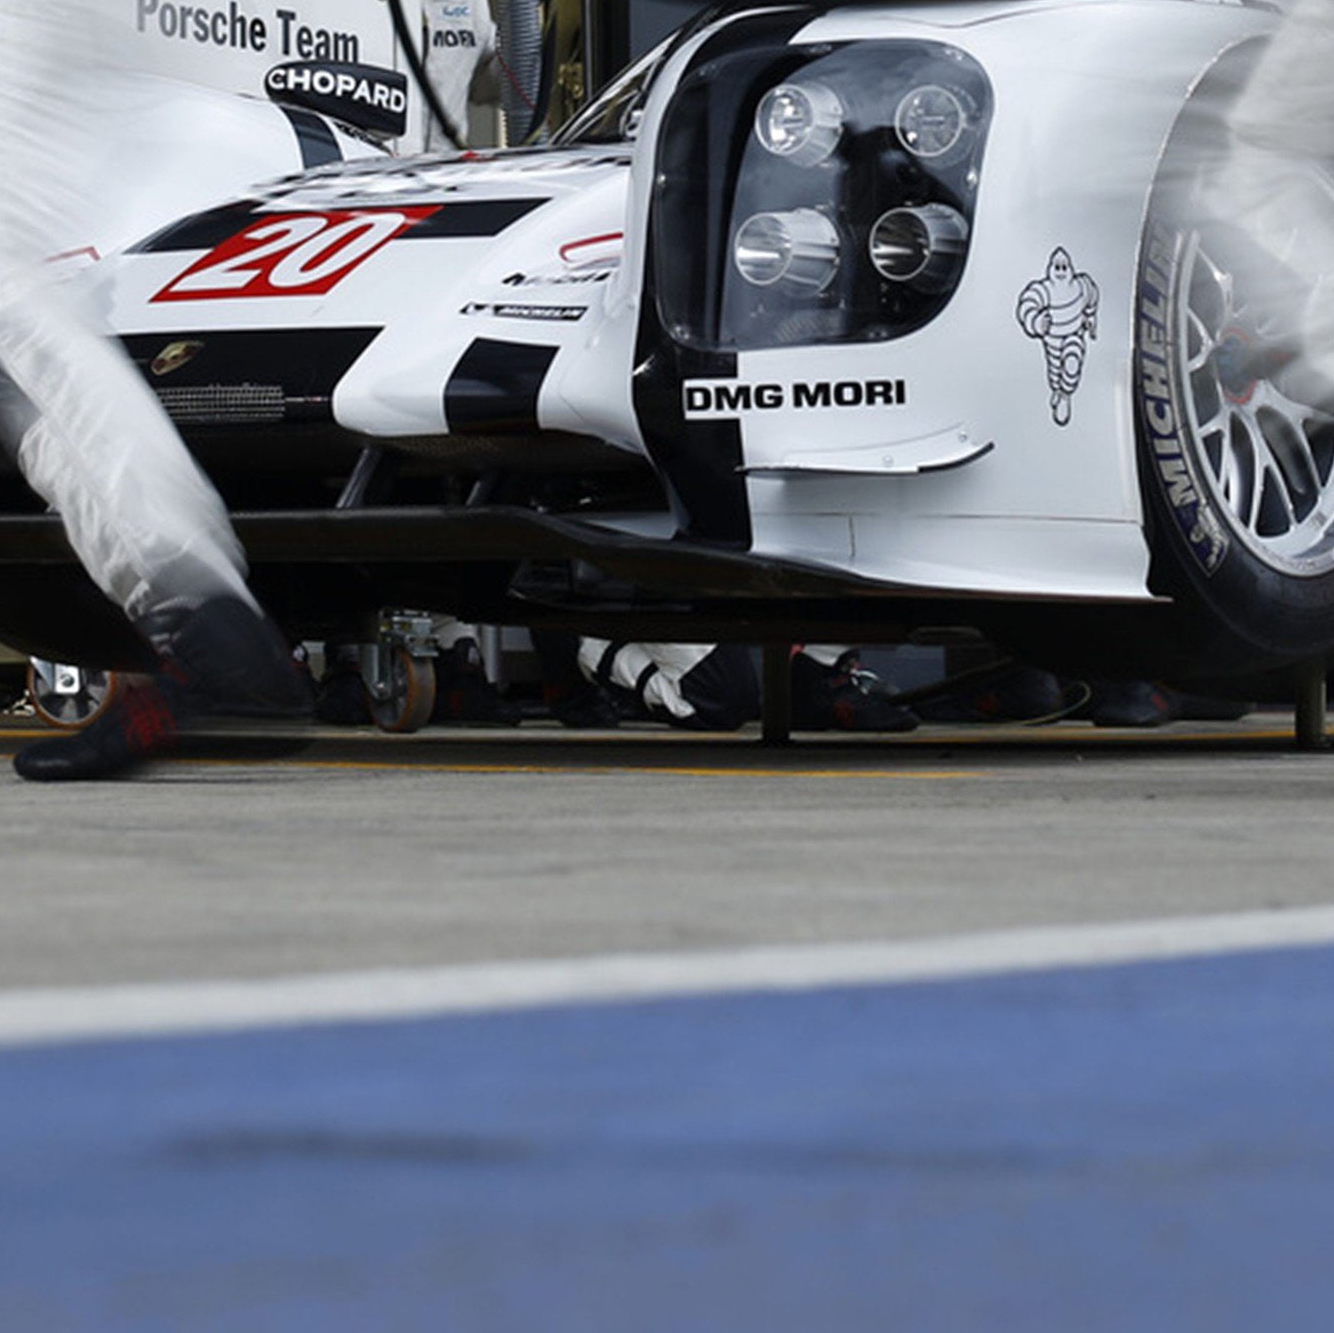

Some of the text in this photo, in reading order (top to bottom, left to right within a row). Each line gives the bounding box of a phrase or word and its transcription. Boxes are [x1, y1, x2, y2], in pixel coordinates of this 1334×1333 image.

[276, 9, 359, 65] Team
[268, 69, 406, 114] CHOPARD
[169, 212, 406, 291] 20
[1139, 222, 1199, 510] MICHELIN
[685, 380, 907, 413] DMG MORI
